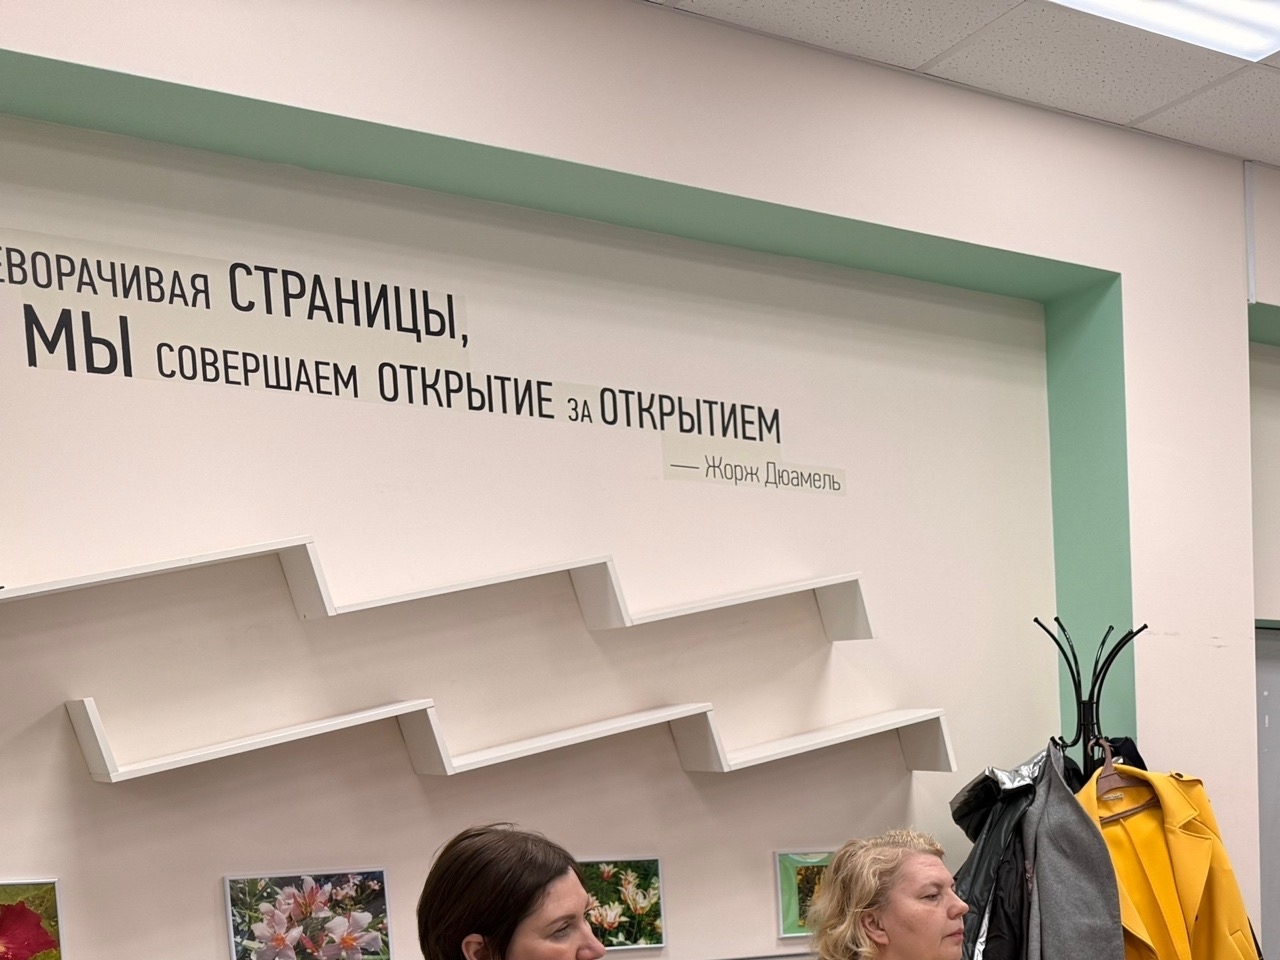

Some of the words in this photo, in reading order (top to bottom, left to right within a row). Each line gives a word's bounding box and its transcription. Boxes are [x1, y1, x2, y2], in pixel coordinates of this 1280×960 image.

[0, 246, 211, 310] ВОРАЧИВАЯ
[228, 262, 467, 348] СТРАНИЦЫ,
[23, 303, 133, 378] МЫ
[156, 343, 359, 398] СОВЕРШАЕМ
[379, 362, 555, 419] ОТКРЫТИЕ
[567, 397, 593, 424] ЗА
[600, 387, 782, 444] ОТКРЫТИЕМ
[705, 455, 760, 486] Жорж
[765, 461, 841, 492] Дюамель
